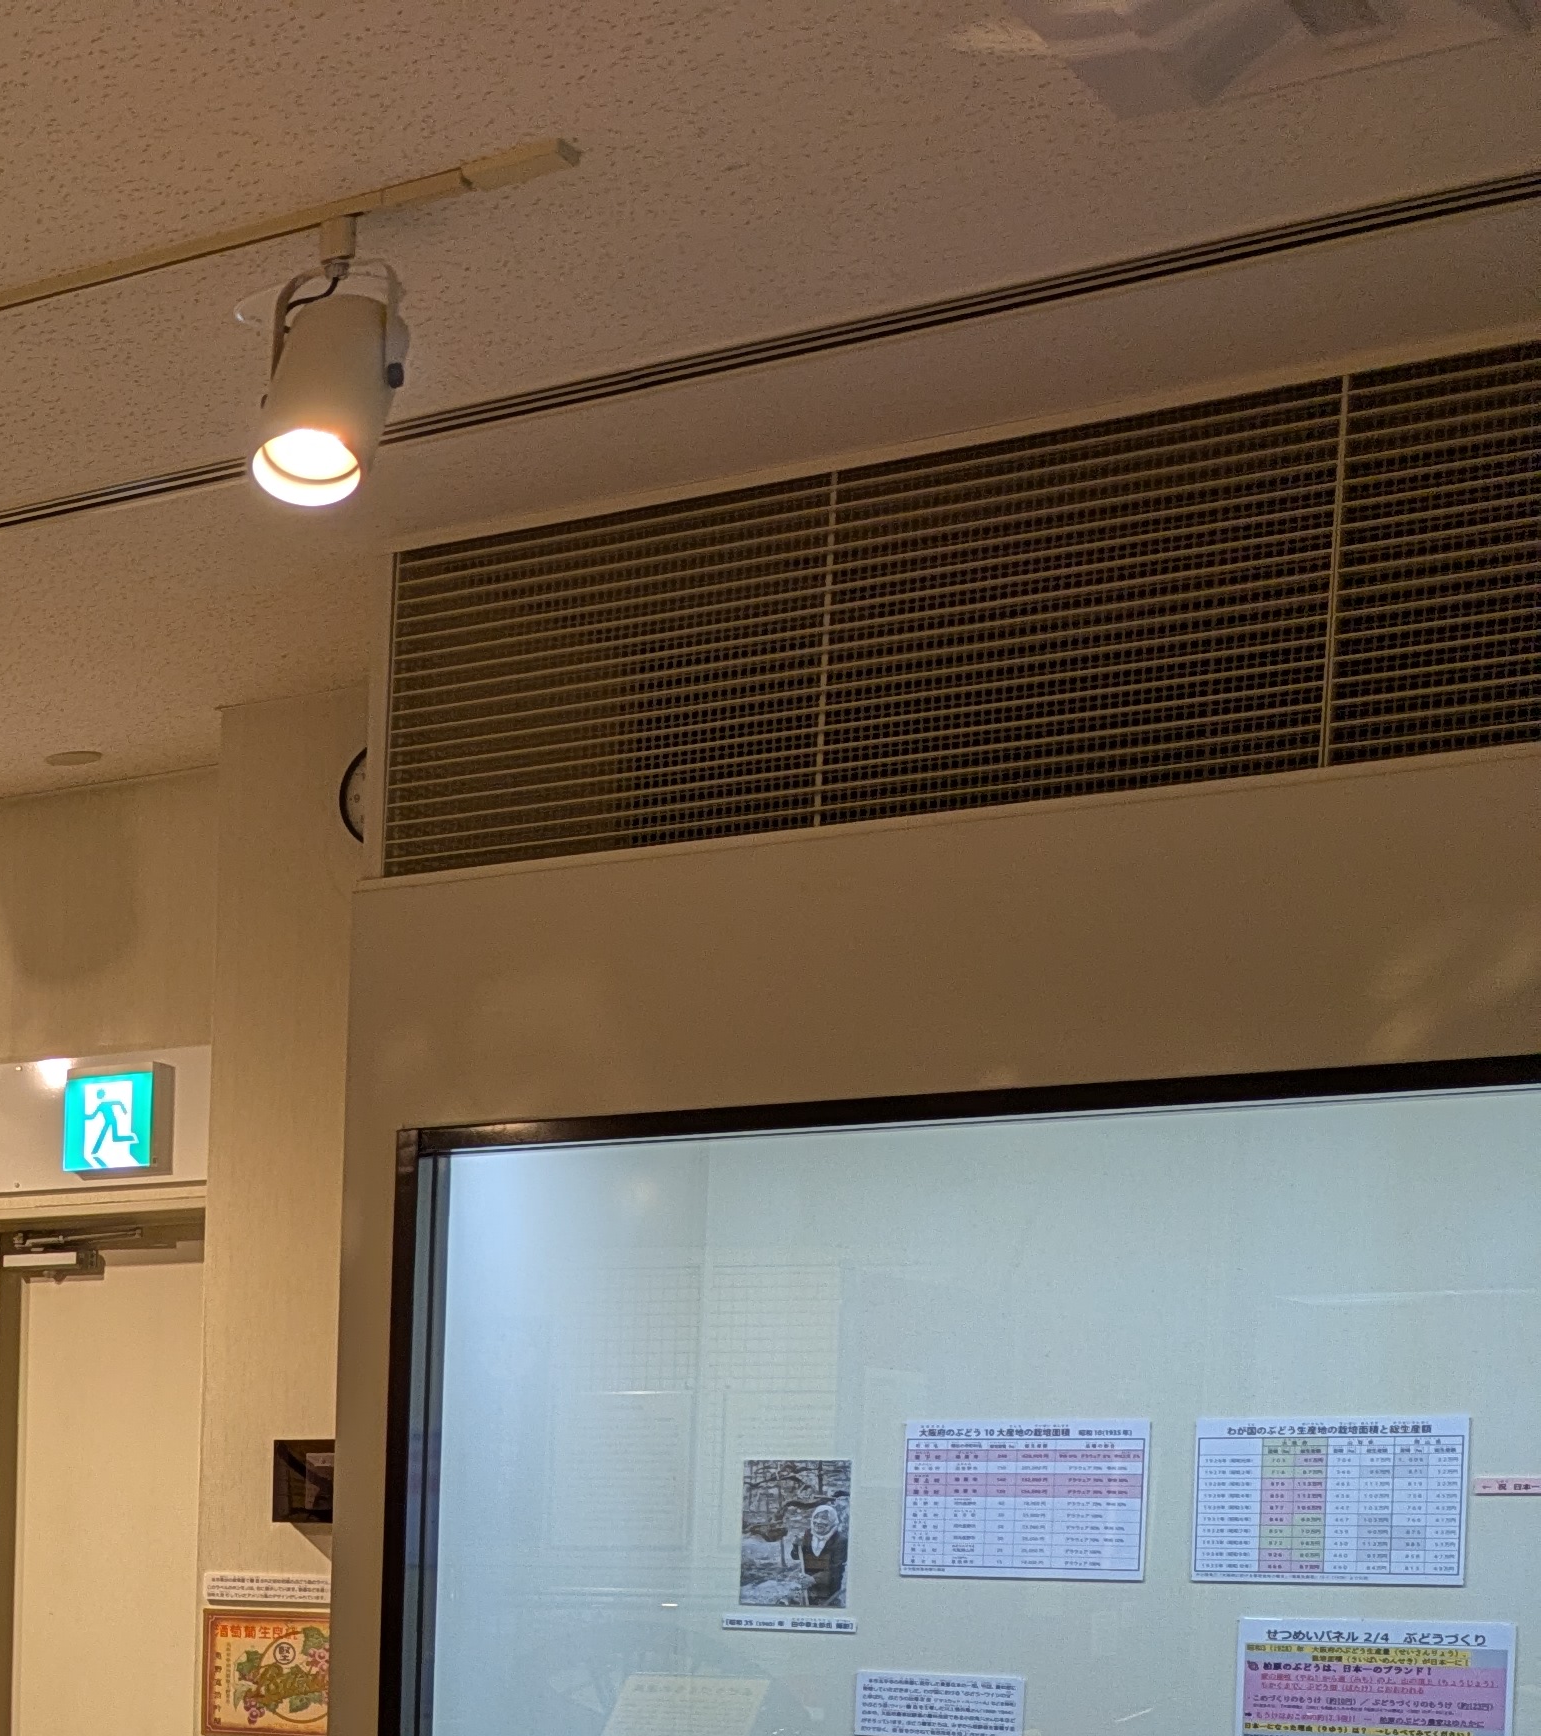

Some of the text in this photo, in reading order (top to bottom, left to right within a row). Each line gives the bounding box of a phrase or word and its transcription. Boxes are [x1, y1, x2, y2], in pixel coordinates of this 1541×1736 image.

[1266, 1628, 1487, 1647] せつめいパネル 2/4 ぶどうづくり
